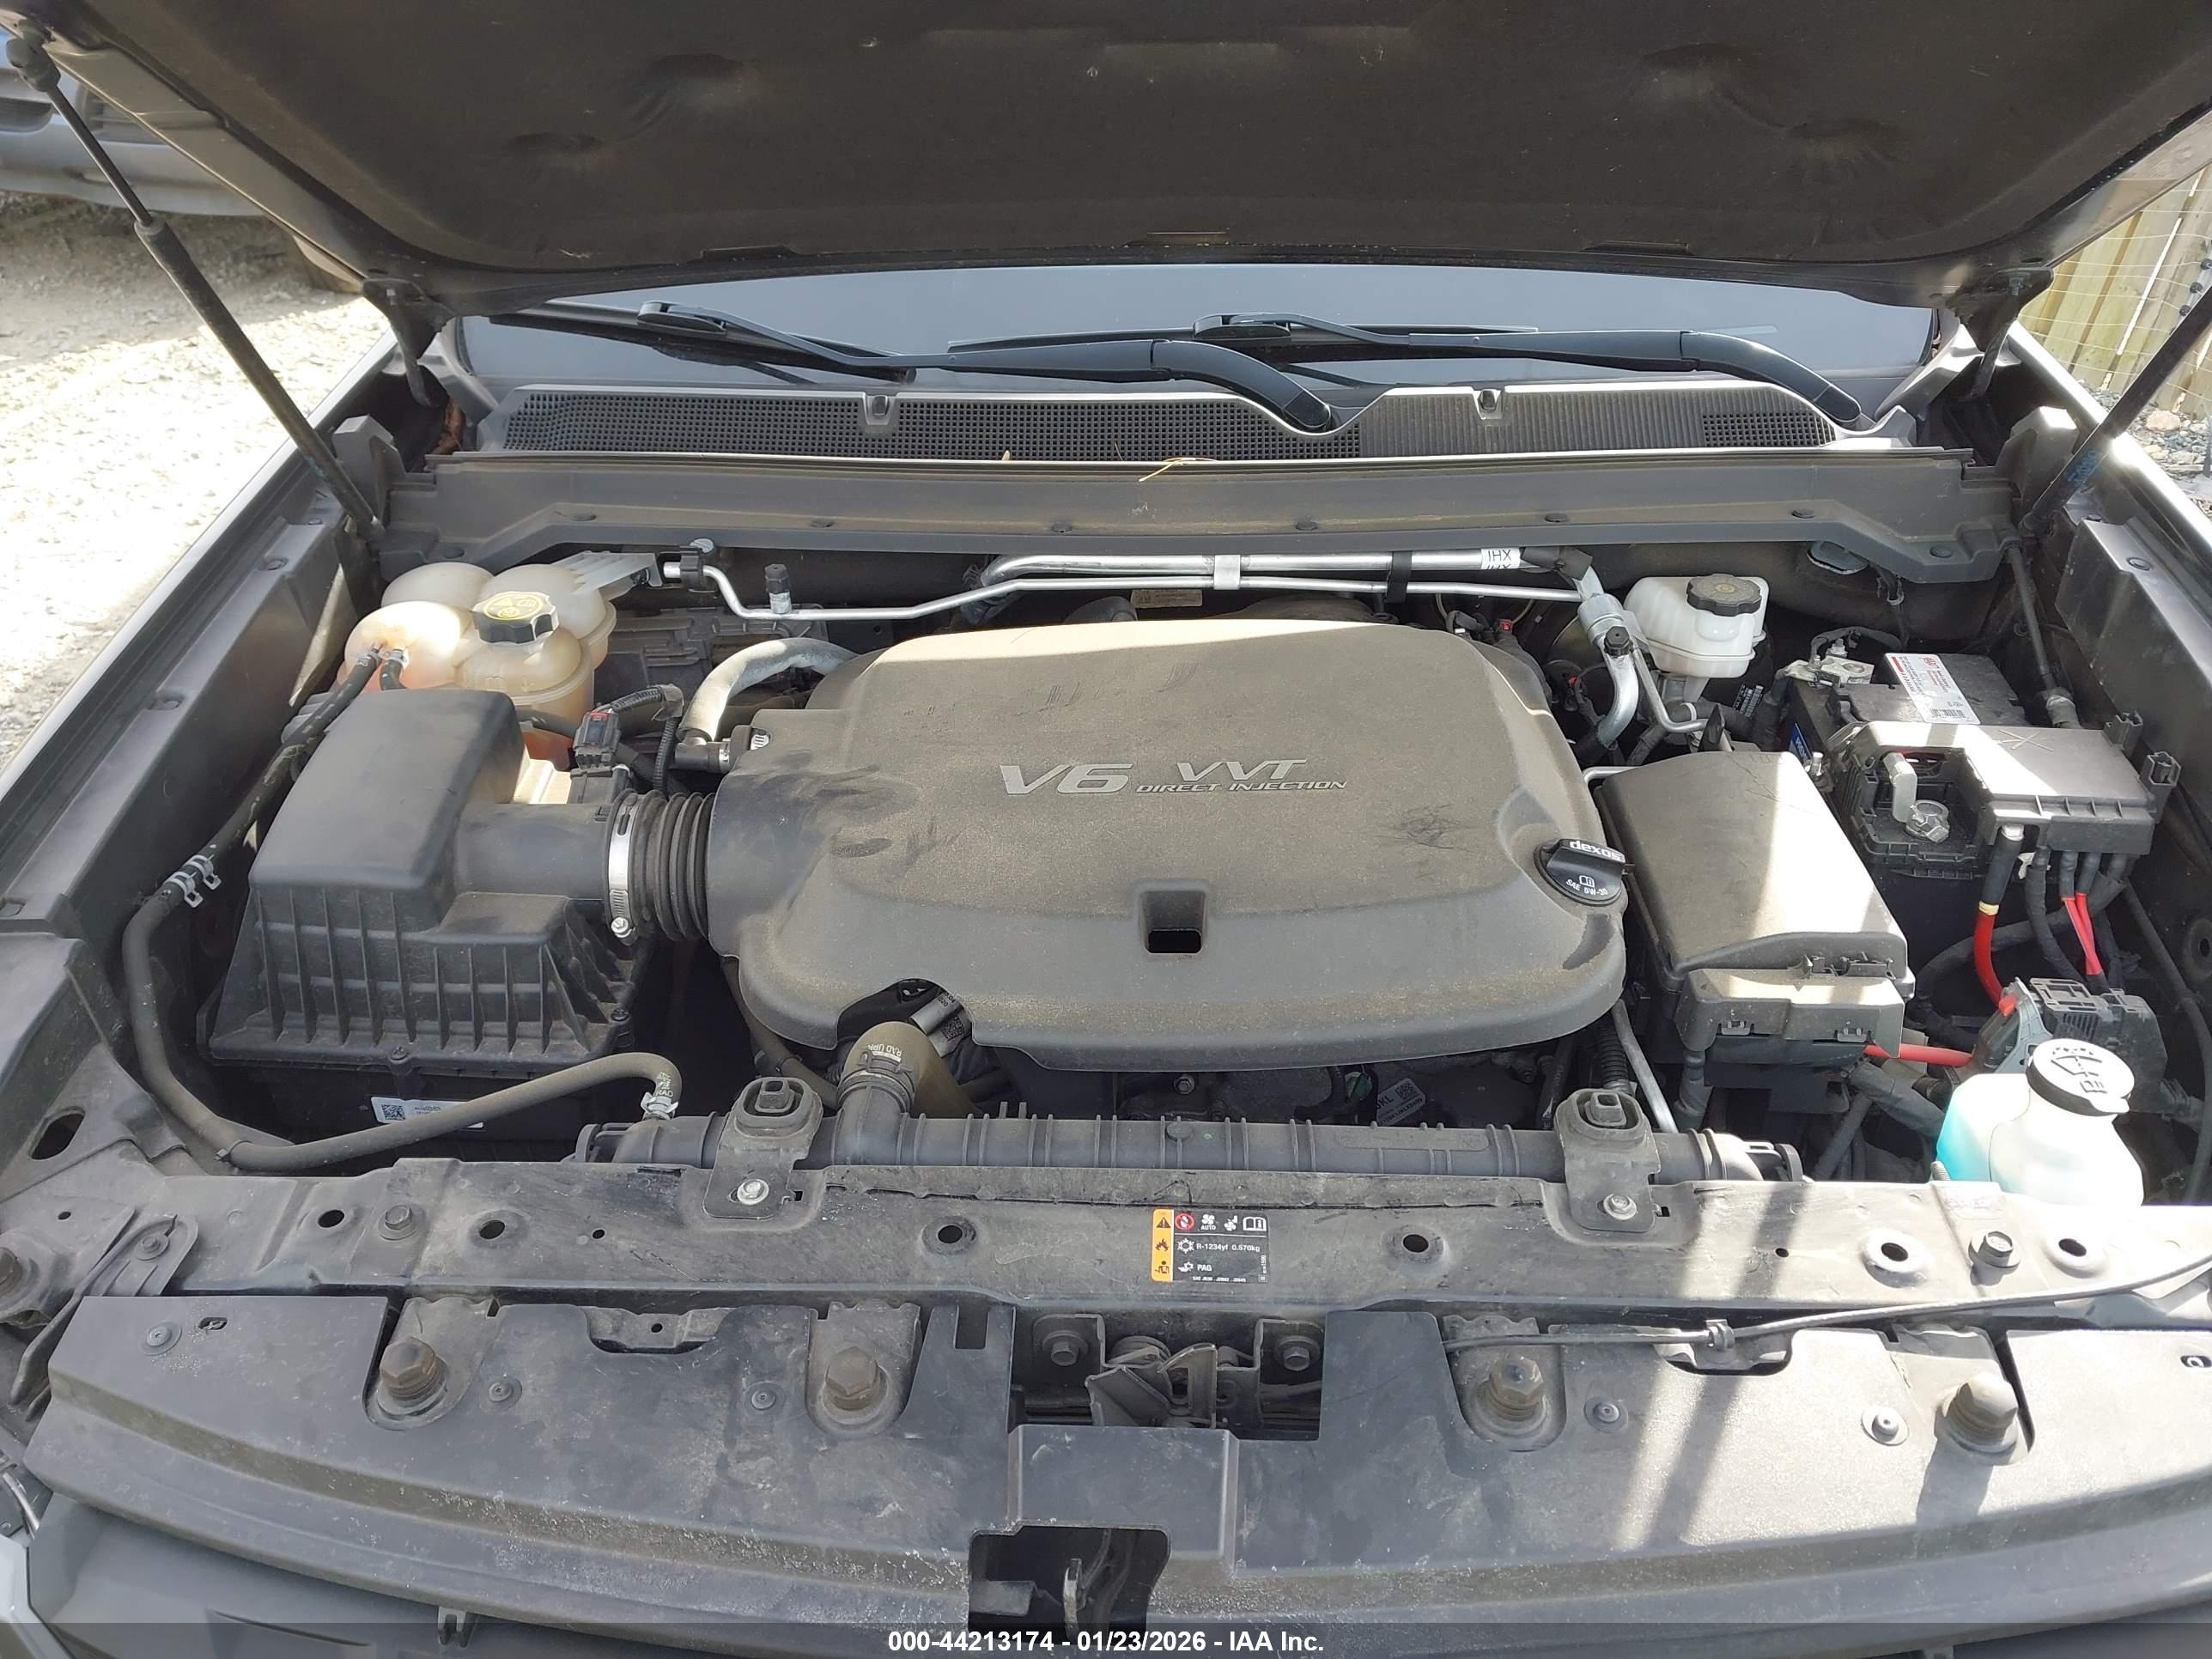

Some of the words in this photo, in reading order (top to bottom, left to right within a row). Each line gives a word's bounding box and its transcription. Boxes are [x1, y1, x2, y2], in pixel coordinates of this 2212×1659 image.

[1000, 763, 1133, 794] V6
[1176, 759, 1308, 781] VVT
[1135, 783, 1218, 793] DIRECT
[1229, 781, 1348, 792] INJECTION
[1569, 840, 1625, 862] dexos
[1565, 878, 1581, 891] SAE
[1583, 886, 1608, 896] 5W-30
[886, 1044, 902, 1057] RAD
[1231, 1243, 1261, 1253] 0.570kg
